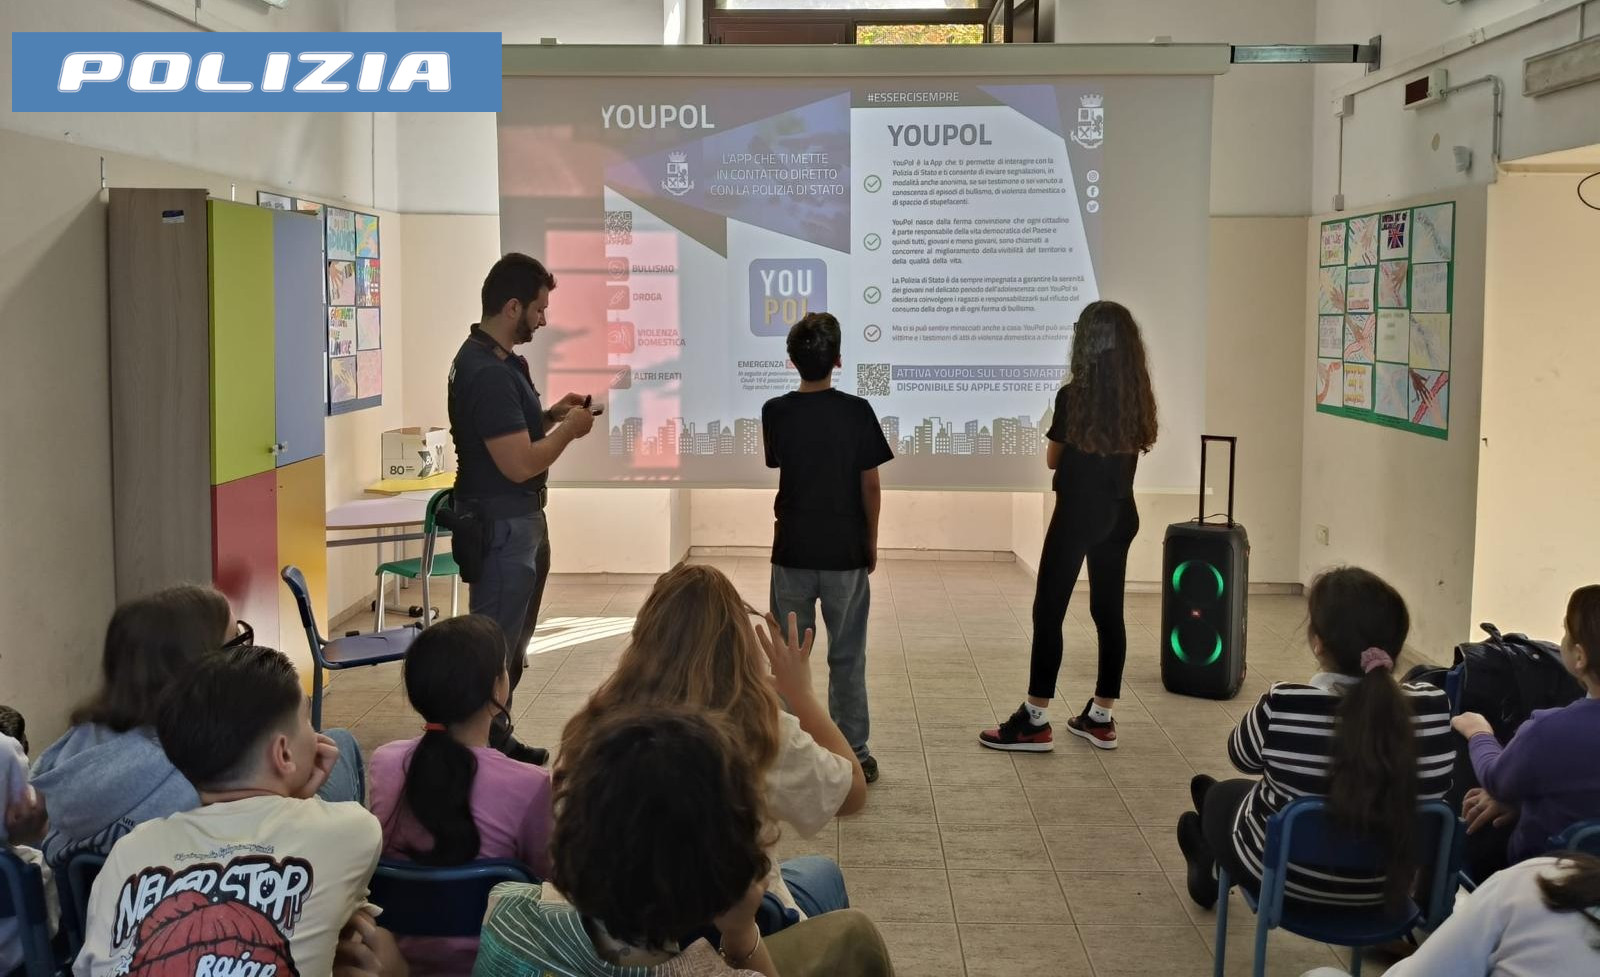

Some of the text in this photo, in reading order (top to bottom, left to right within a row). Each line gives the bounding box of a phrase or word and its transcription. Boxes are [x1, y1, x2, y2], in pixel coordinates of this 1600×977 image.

[867, 91, 959, 102] #ESSERCISEMPRE
[601, 104, 715, 129] YOUPOL
[887, 123, 992, 146] YOUPOL
[722, 153, 828, 164] L'APP CHE TI METTE
[716, 169, 838, 180] IN CONTATTO DIRETTO
[710, 184, 844, 196] CON LA POLIZIA DI STATO
[632, 264, 674, 272] BULLISMO
[760, 270, 812, 296] YOU
[633, 293, 662, 301] DROGA
[738, 360, 784, 368] EMERGENZA
[634, 372, 682, 380] ALTRI REATI
[897, 369, 1066, 378] ATTIVA YOUPOL SUL TUO SMARTP
[897, 383, 954, 391] DISPONIBILE
[956, 383, 968, 391] SU
[971, 383, 1000, 391] APPLE
[1003, 383, 1032, 391] STORE
[1036, 383, 1040, 391] E
[390, 466, 404, 475] 80
[219, 862, 309, 924] STOP
